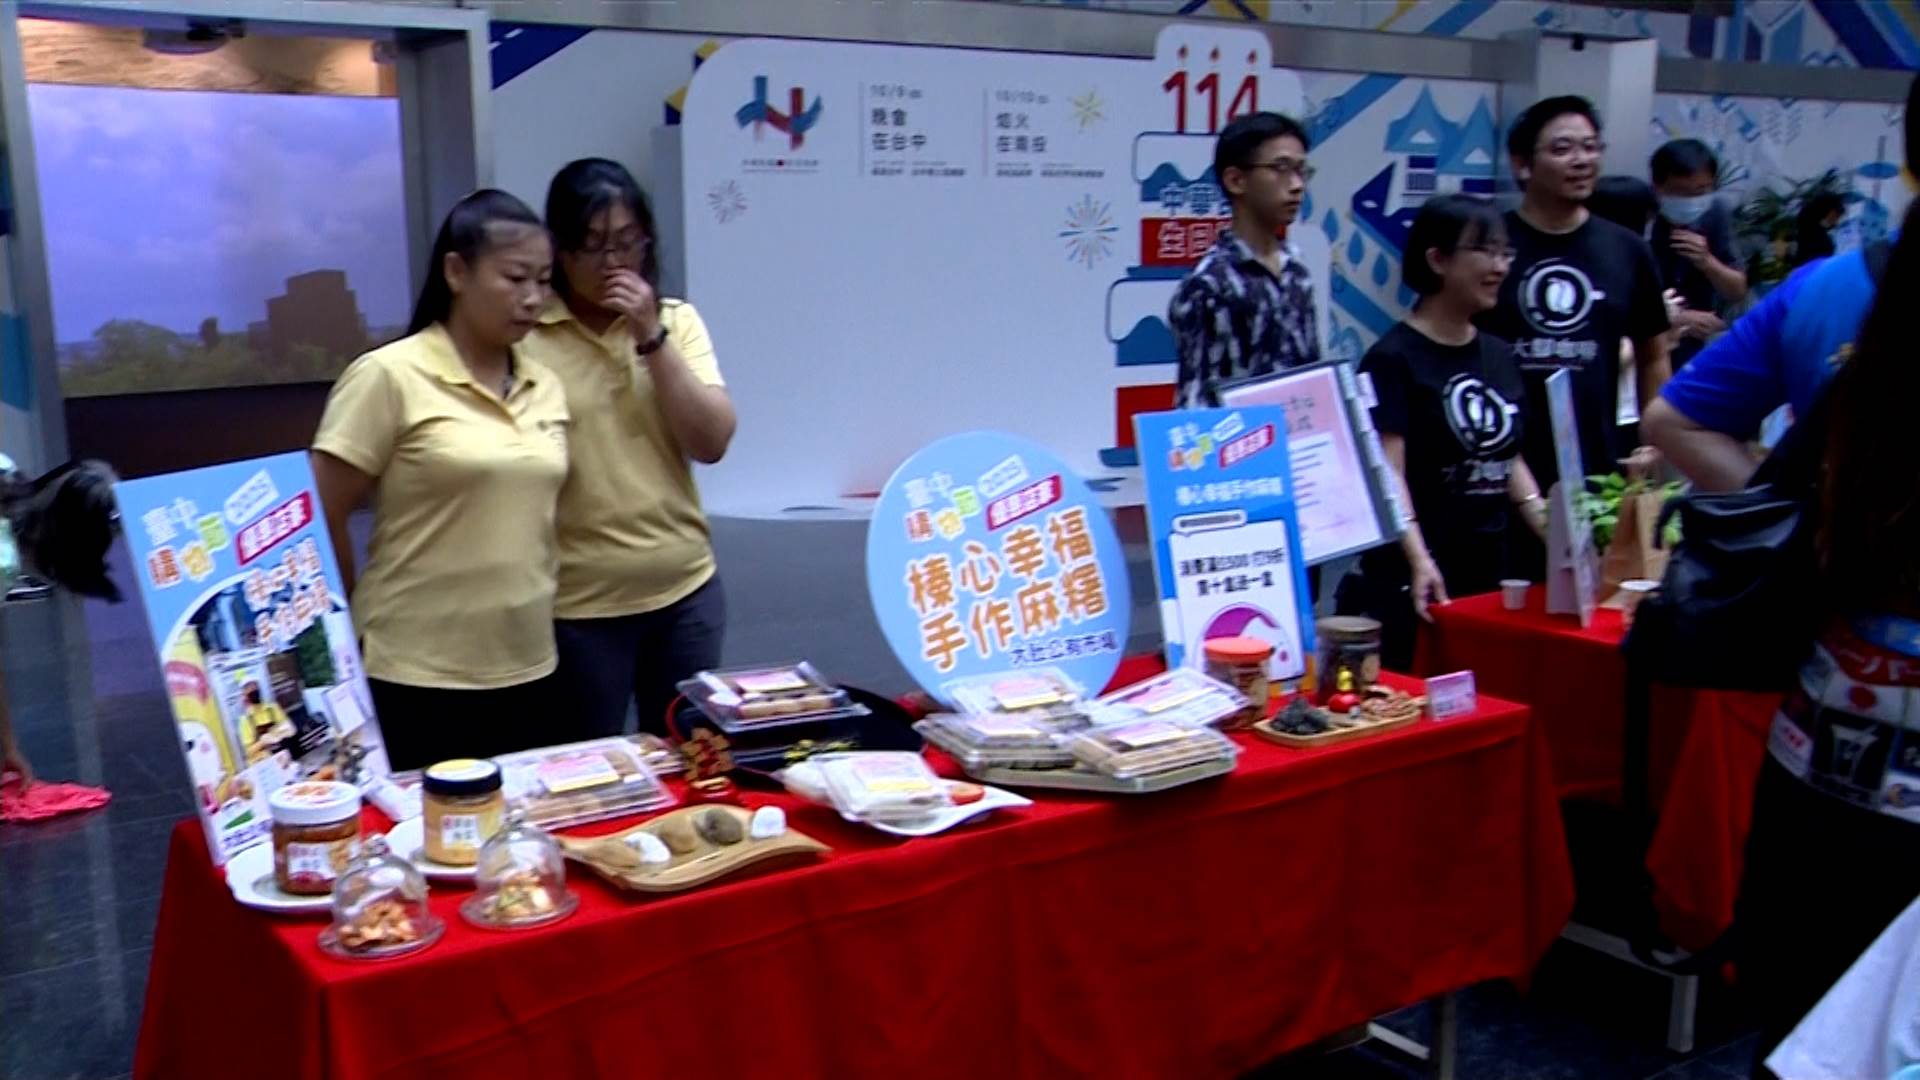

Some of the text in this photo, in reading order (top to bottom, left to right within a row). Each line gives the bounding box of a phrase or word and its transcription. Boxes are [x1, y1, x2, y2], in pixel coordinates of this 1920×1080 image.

[871, 132, 927, 151] 在台中
[1162, 70, 1260, 136] 114
[907, 507, 1095, 615] 榛心幸福
[921, 562, 1107, 670] 手作麻糬
